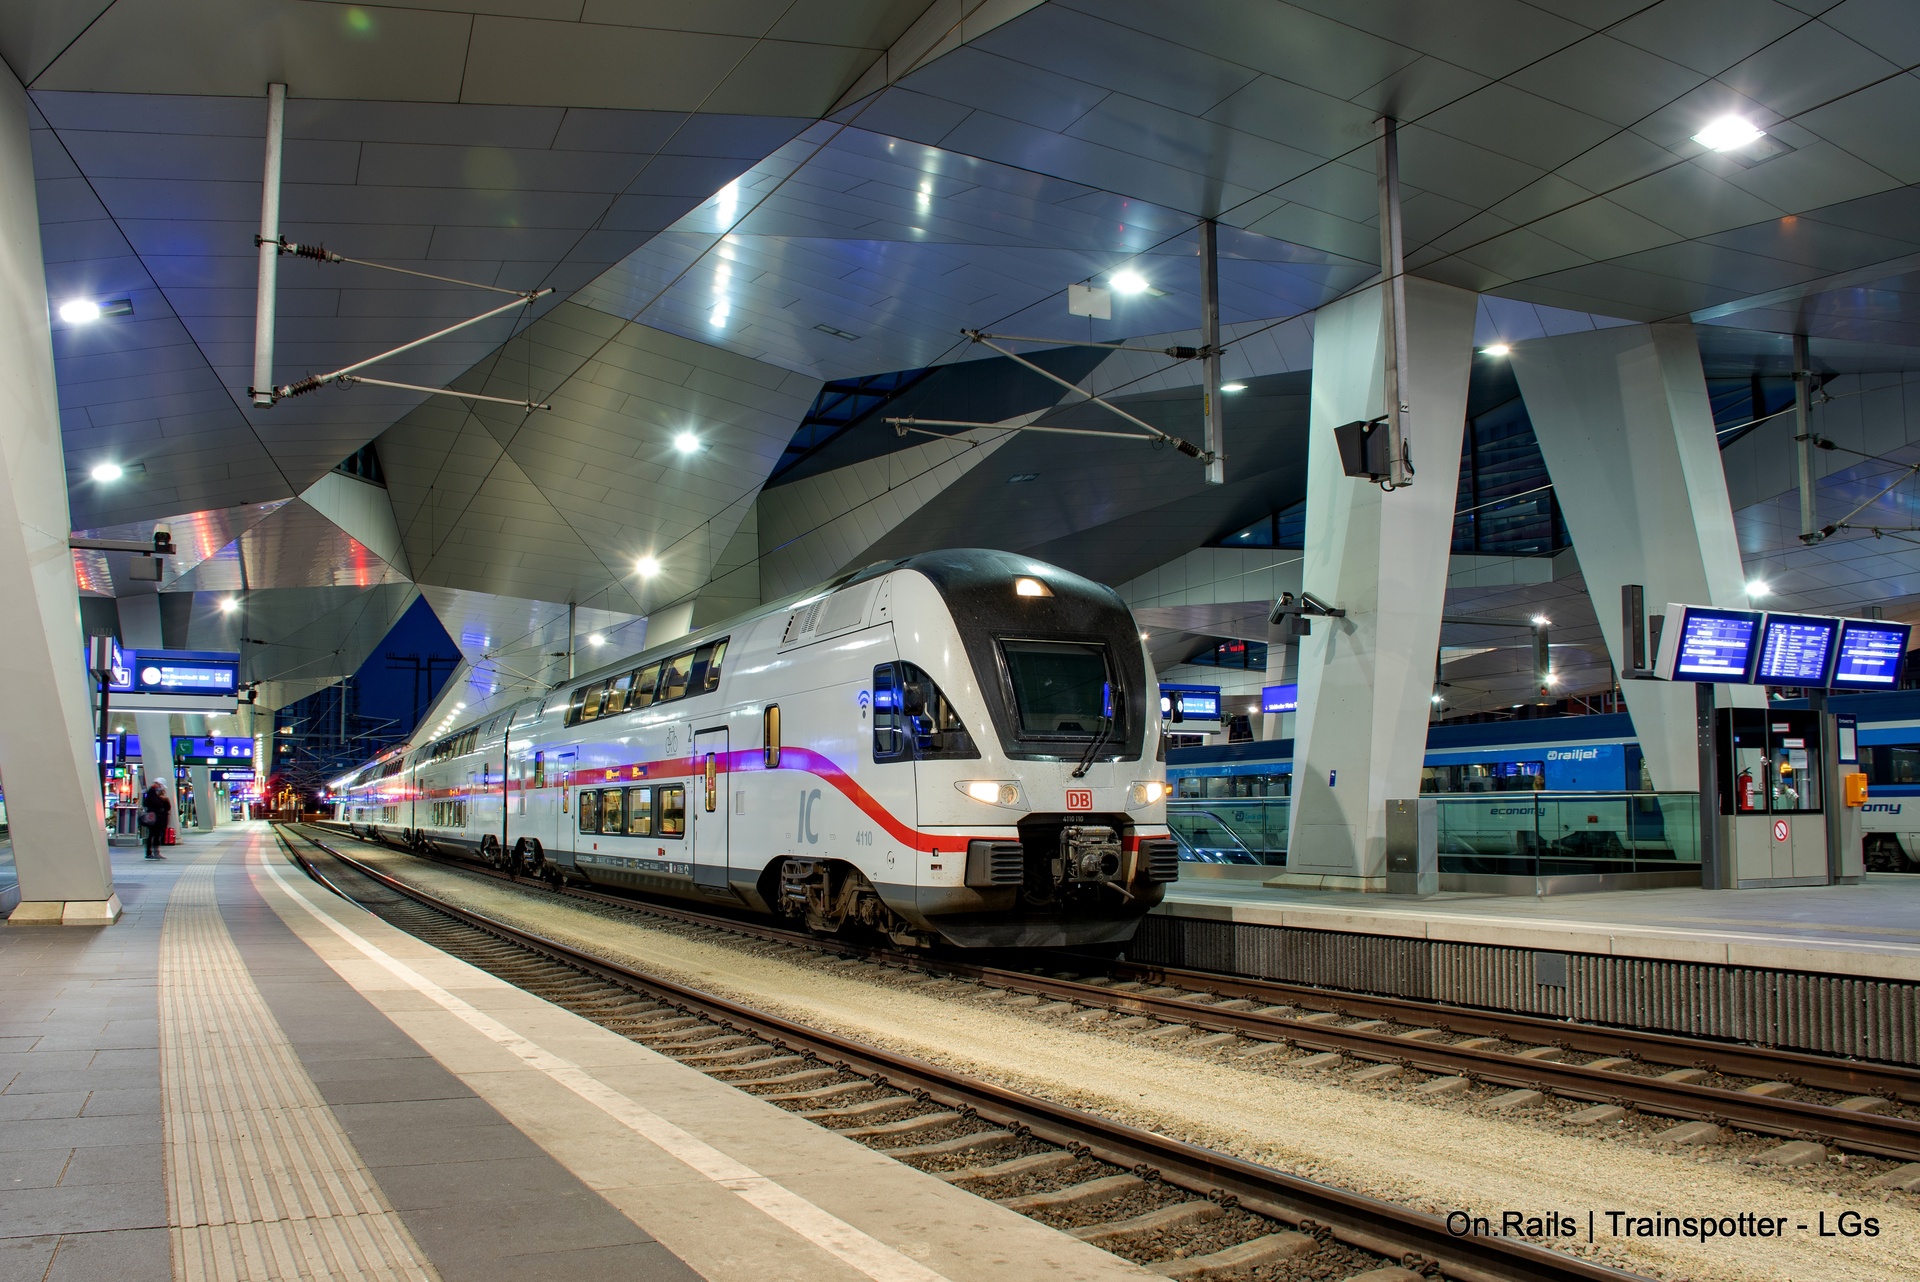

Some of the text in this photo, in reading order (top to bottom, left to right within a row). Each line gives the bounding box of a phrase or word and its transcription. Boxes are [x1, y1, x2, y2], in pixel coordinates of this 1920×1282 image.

[687, 723, 692, 743] 2
[231, 746, 239, 756] 6
[1557, 748, 1598, 761] railjet
[1069, 792, 1090, 808] DB
[797, 788, 822, 845] IC
[1490, 807, 1546, 817] economy
[855, 830, 873, 847] 4110
